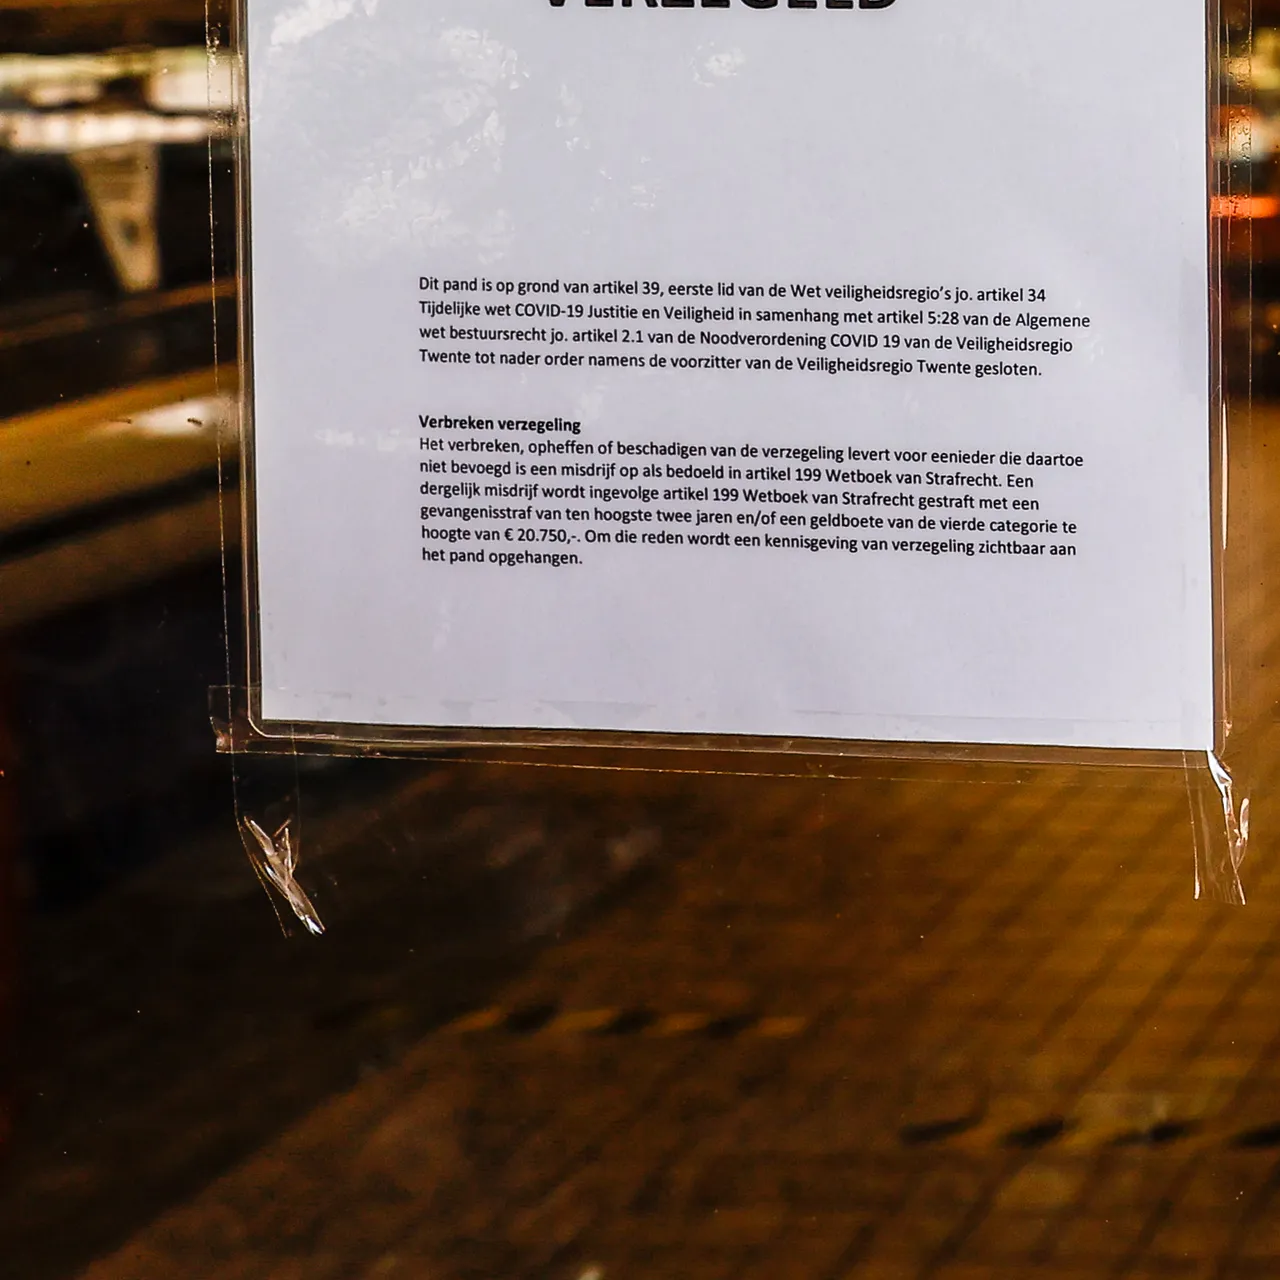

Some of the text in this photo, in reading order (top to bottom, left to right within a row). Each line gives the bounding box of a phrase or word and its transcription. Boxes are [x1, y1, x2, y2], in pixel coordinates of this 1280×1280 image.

[419, 276, 439, 291] Dit
[443, 277, 477, 294] pand
[482, 278, 493, 292] is
[496, 281, 515, 295] op
[517, 279, 559, 296] grond
[563, 283, 589, 294] van
[593, 280, 638, 295] artikel
[642, 281, 664, 297] 39,
[668, 284, 714, 296] eerste
[718, 282, 734, 296] lid
[738, 286, 764, 297] van
[768, 283, 787, 297] de
[790, 284, 821, 298] Wet
[954, 287, 973, 304] jo.
[977, 287, 1023, 302] artikel
[1027, 288, 1046, 302] 34
[419, 301, 1090, 330] Tijdelijke wet COVID-19 Justitie en Veiligheid in samenhang met artikel 5:28 van de Algemene
[419, 325, 1073, 355] wet bestuursrecht jo. artikel 2.1 van de Noodverordening COVID 19 van de Veiligheidsregio
[419, 349, 1042, 378] Twente tot nader order namens de voorzitter van de Veiligheidsregio Twente gesloten.
[418, 415, 581, 435] Verbreken verzegeling
[420, 437, 1083, 467] Het verbreken, opheffen of beschadigen van de verzegeling levert voor eenieder die daartoe
[420, 481, 1039, 510] dergelijk misdrijf wordt ingevolge artikel 199 Wetboek van Strafrecht gestraft met een
[422, 525, 1076, 556] hoogte van € 20.750,-. Om die reden wordt een kennisgeving van verzegeling zichtbaar aan
[422, 547, 583, 567] het pand opgehangen.
